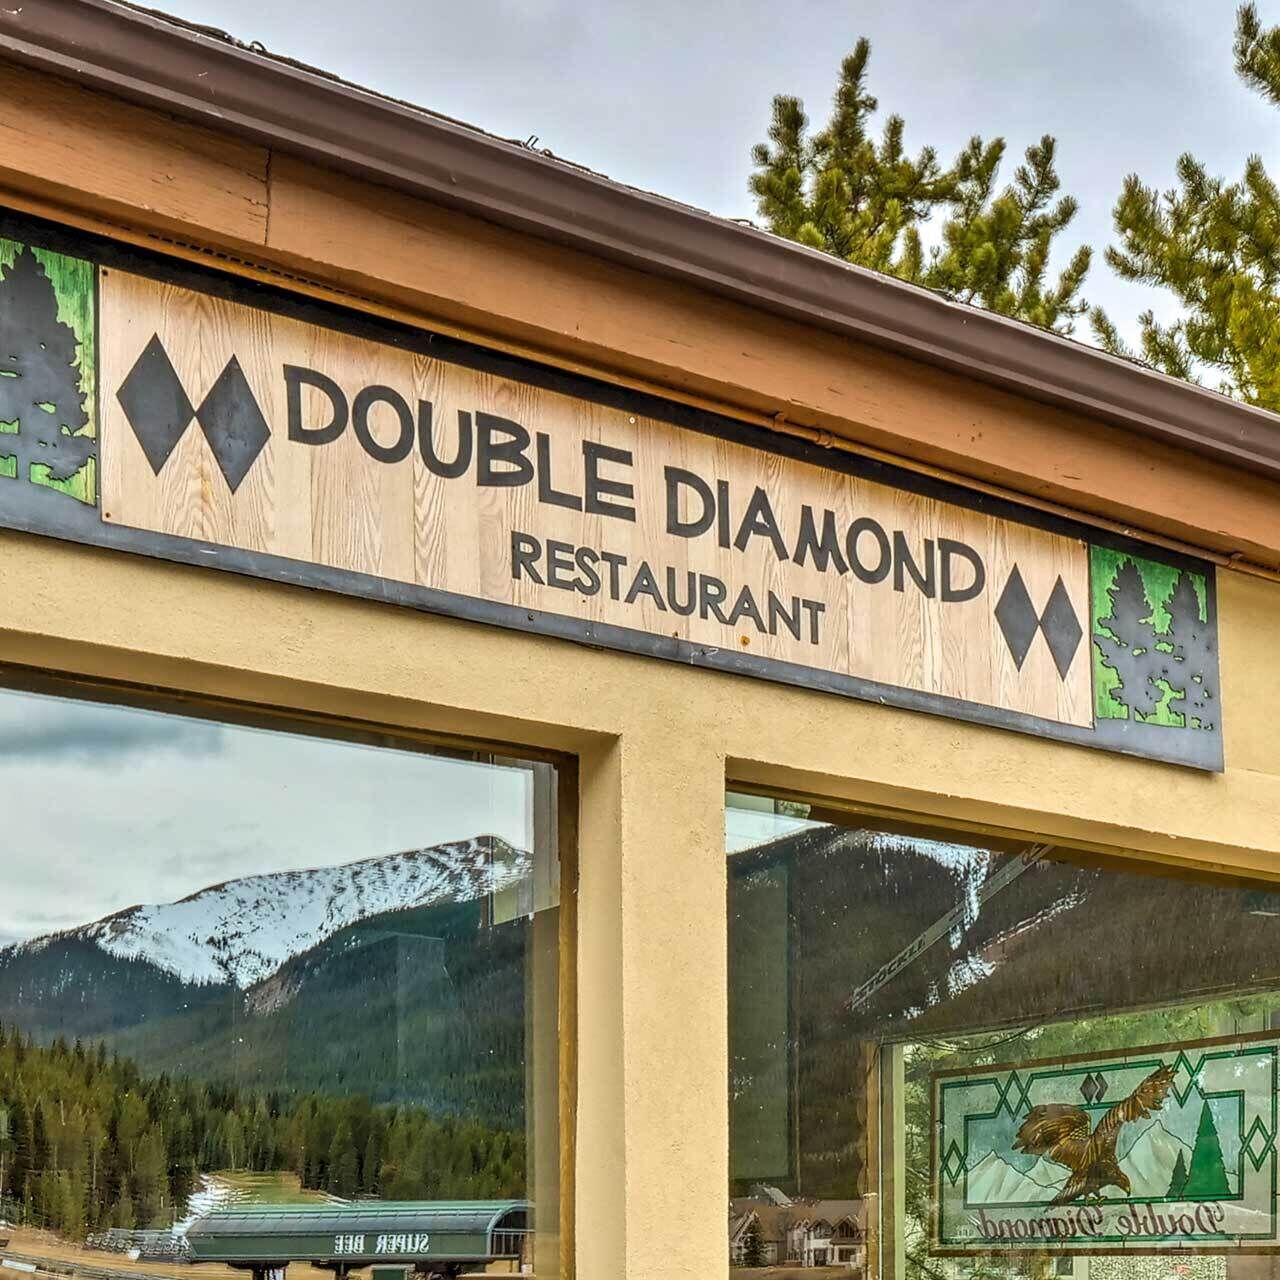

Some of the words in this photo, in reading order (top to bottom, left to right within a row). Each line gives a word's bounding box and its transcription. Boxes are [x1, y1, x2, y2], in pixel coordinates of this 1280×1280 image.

[283, 363, 636, 522] DOUBLE
[664, 465, 986, 602] DIAMOND
[511, 530, 826, 645] RESTAURANT
